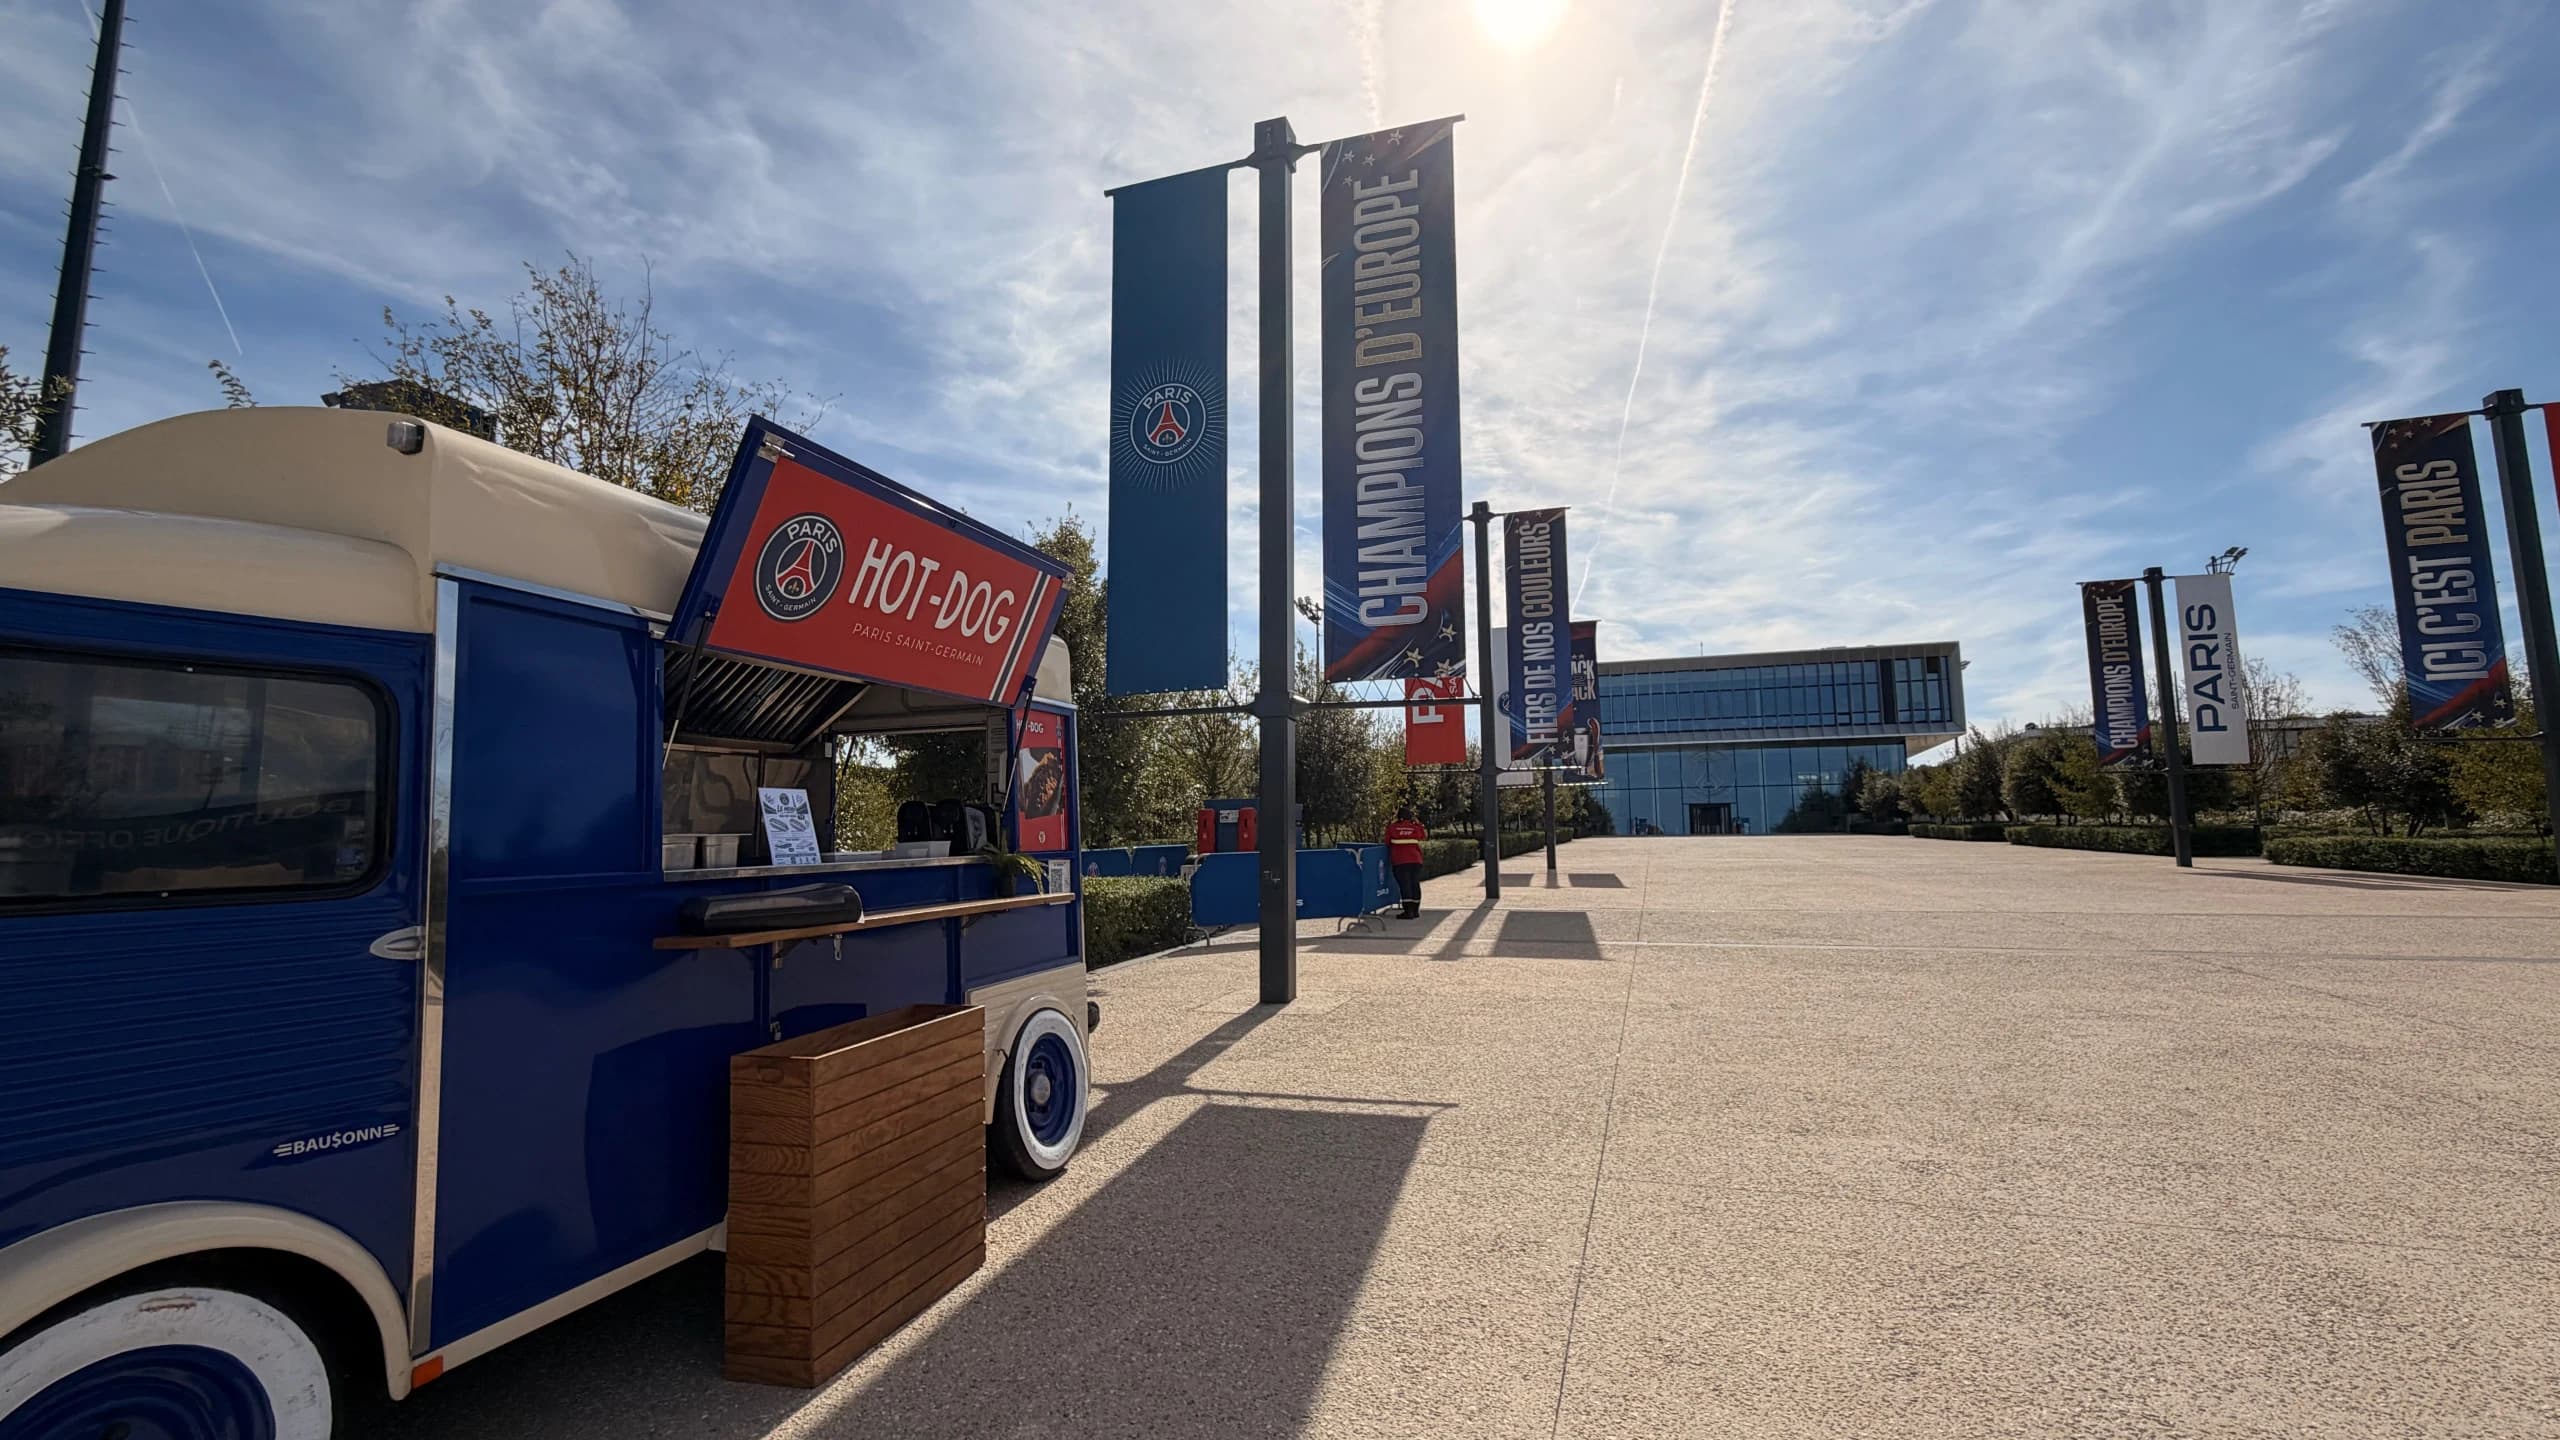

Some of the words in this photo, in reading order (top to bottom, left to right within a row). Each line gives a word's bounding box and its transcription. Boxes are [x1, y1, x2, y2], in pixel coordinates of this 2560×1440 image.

[1352, 168, 1423, 368] D'EUROPE
[1143, 387, 1192, 410] PARIS
[787, 520, 838, 553] PARIS
[1353, 372, 1429, 627] CHAMPIONS
[2395, 458, 2469, 548] PARIS
[848, 537, 1015, 644] HOT-DOG
[1519, 521, 1554, 618] COULEURS
[2408, 555, 2482, 635] C'EST
[852, 623, 893, 643] PARIS
[895, 634, 984, 666] SAINT-GERMAIN
[1522, 621, 1556, 661] NOS
[2096, 594, 2133, 662] D'EUROPE
[2420, 640, 2489, 682] ICI
[1523, 664, 1556, 689] DE
[2103, 662, 2139, 750] CHAMPIONS
[2185, 604, 2228, 732] PARIS
[2223, 632, 2240, 710] SAINT-GERMAIN
[1524, 692, 1559, 744] FIERS
